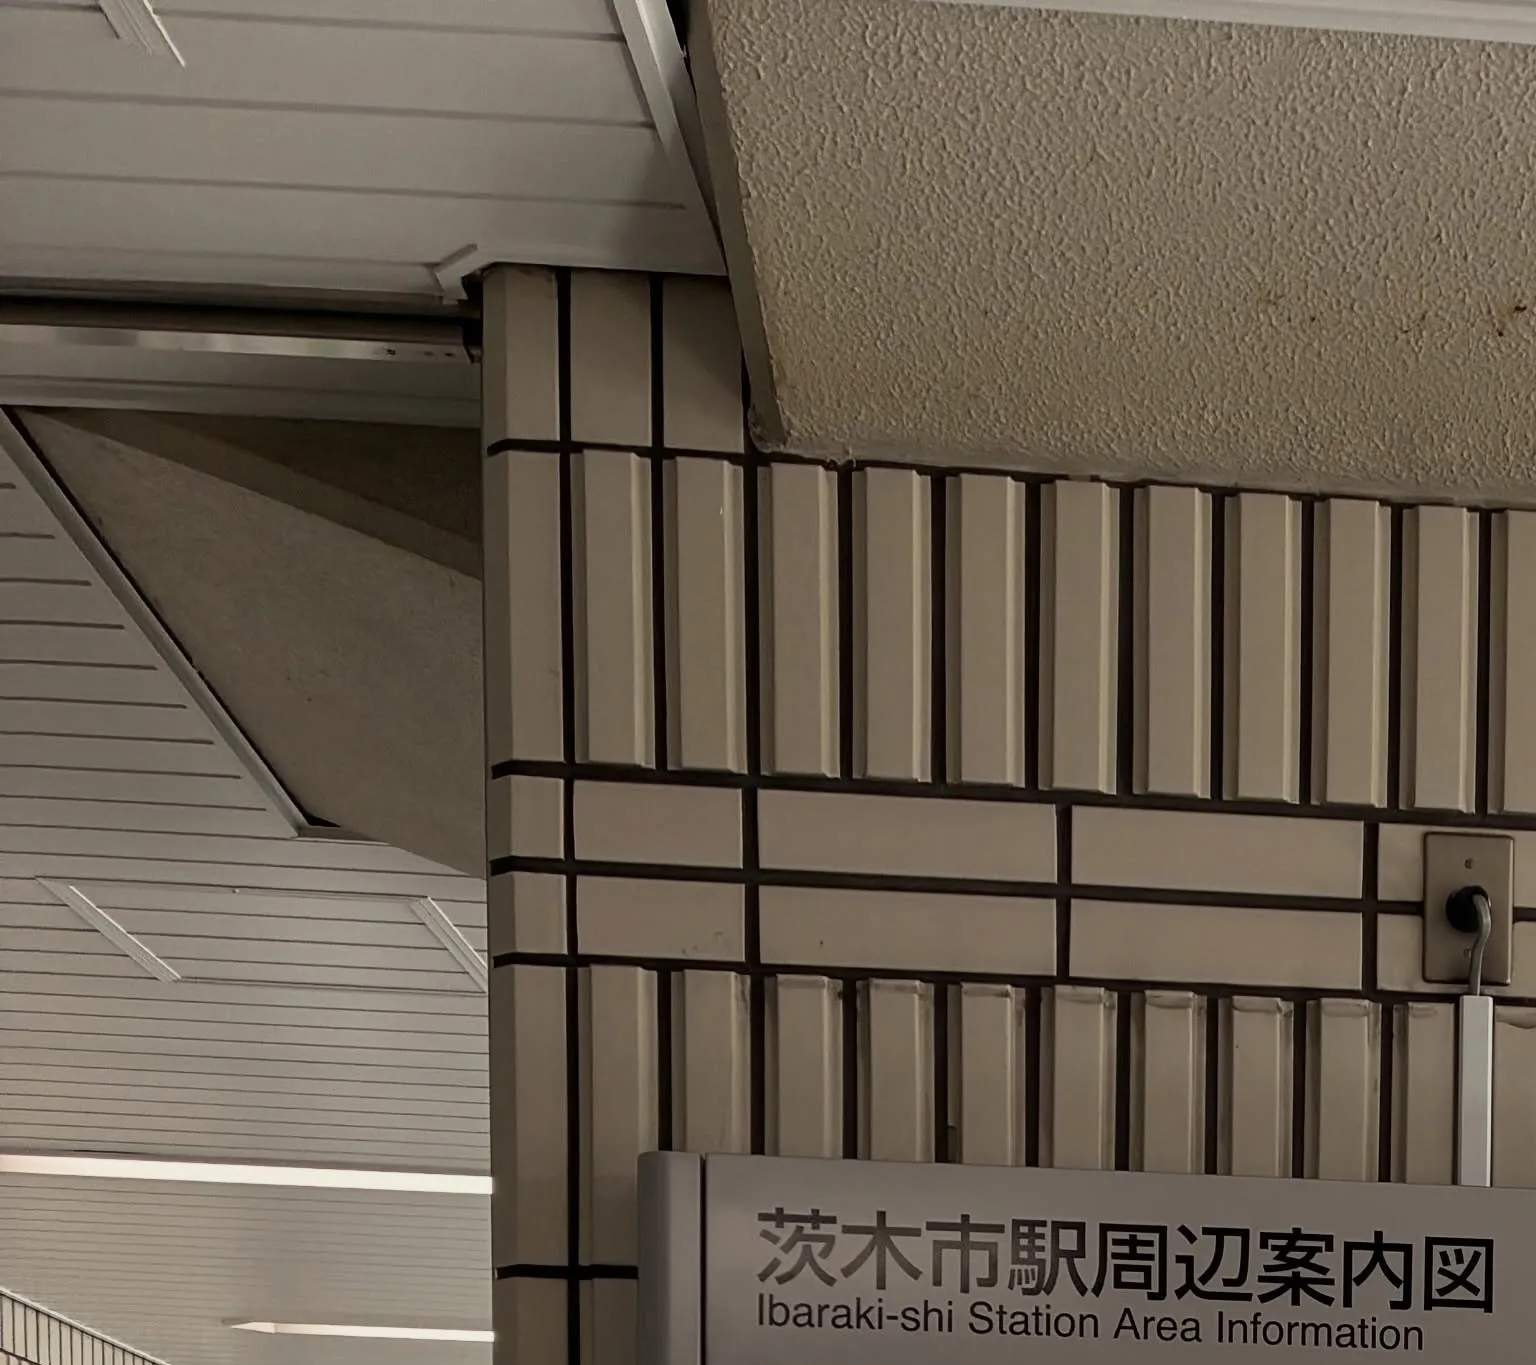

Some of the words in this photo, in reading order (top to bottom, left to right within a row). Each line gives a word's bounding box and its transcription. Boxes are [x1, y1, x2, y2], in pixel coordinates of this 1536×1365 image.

[756, 1206, 1494, 1314] 茨木市駅周辺案内図
[758, 1292, 954, 1334] Ibaraki-shi
[969, 1301, 1099, 1338] Station
[1113, 1308, 1201, 1342] Area
[1216, 1311, 1424, 1351] Information
